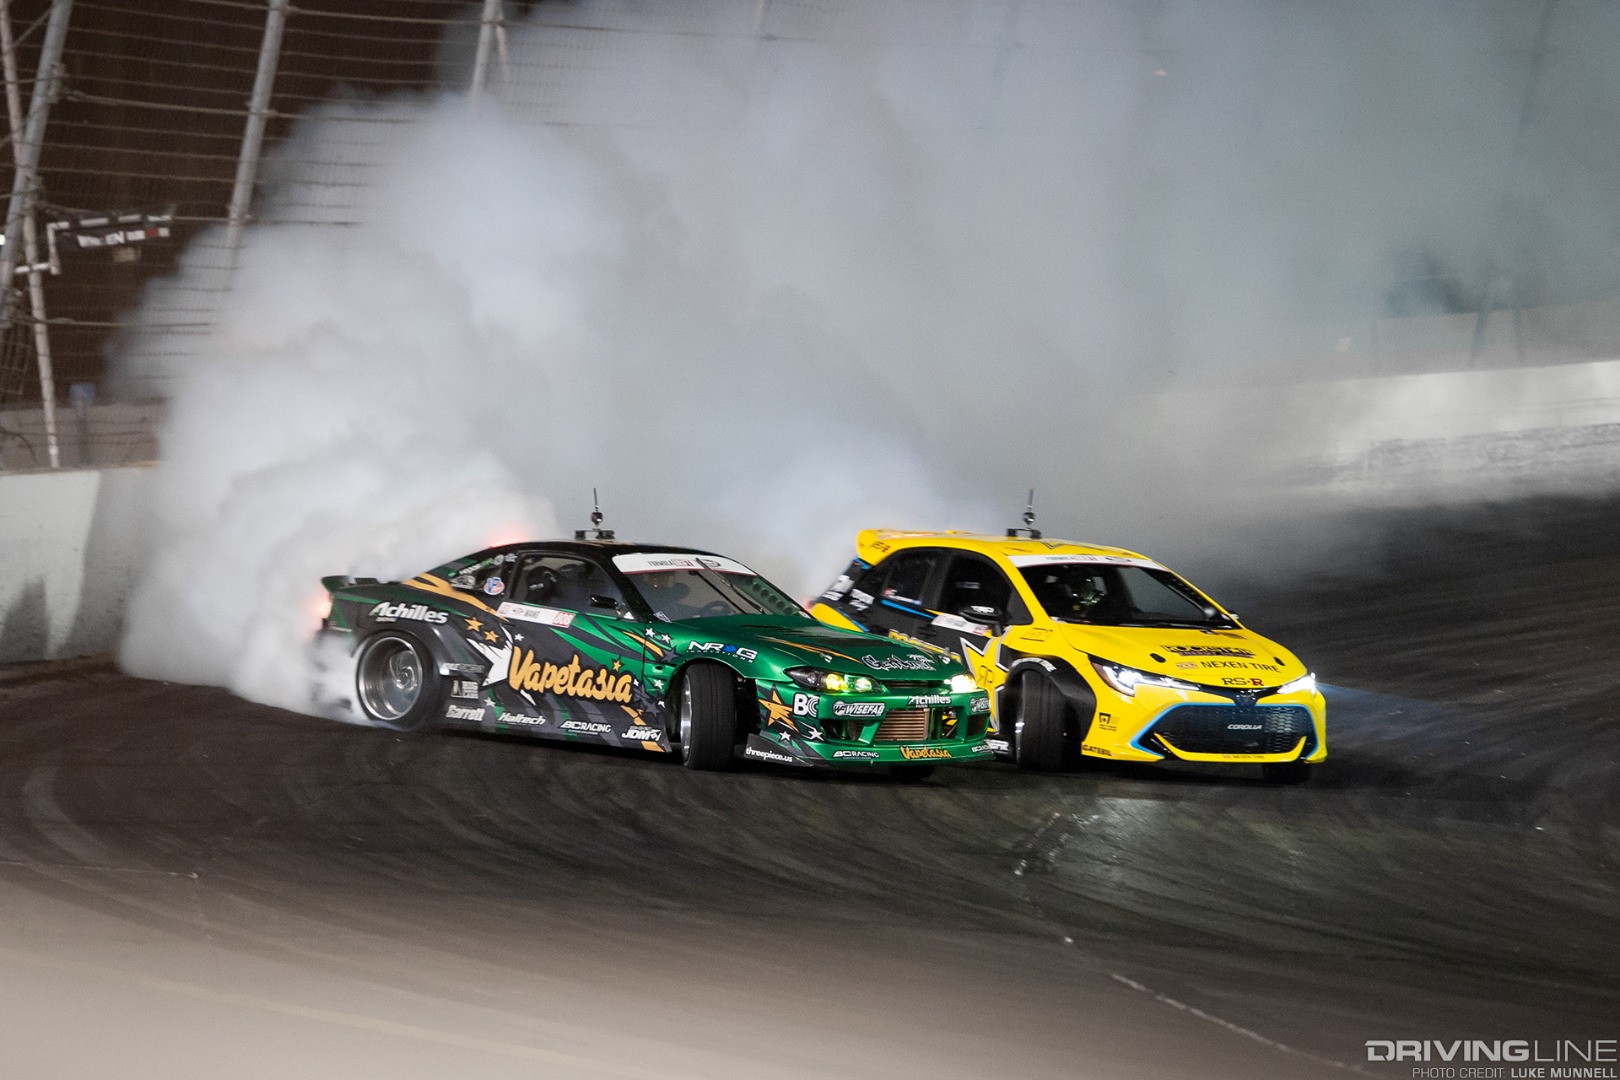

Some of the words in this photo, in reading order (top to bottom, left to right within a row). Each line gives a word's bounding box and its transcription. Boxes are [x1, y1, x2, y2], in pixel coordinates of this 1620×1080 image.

[368, 601, 449, 624] Achilles
[1200, 661, 1248, 670] NEXEN
[1249, 662, 1281, 673] TIRE
[508, 645, 633, 703] Vapetasia
[908, 695, 951, 706] Achilles
[446, 704, 486, 722] Garrett
[845, 704, 885, 715] WISEFAB
[498, 712, 546, 725] Haltech
[621, 729, 650, 741] JDM
[745, 746, 793, 763] threepiece.us
[900, 746, 952, 760] Vapetasia
